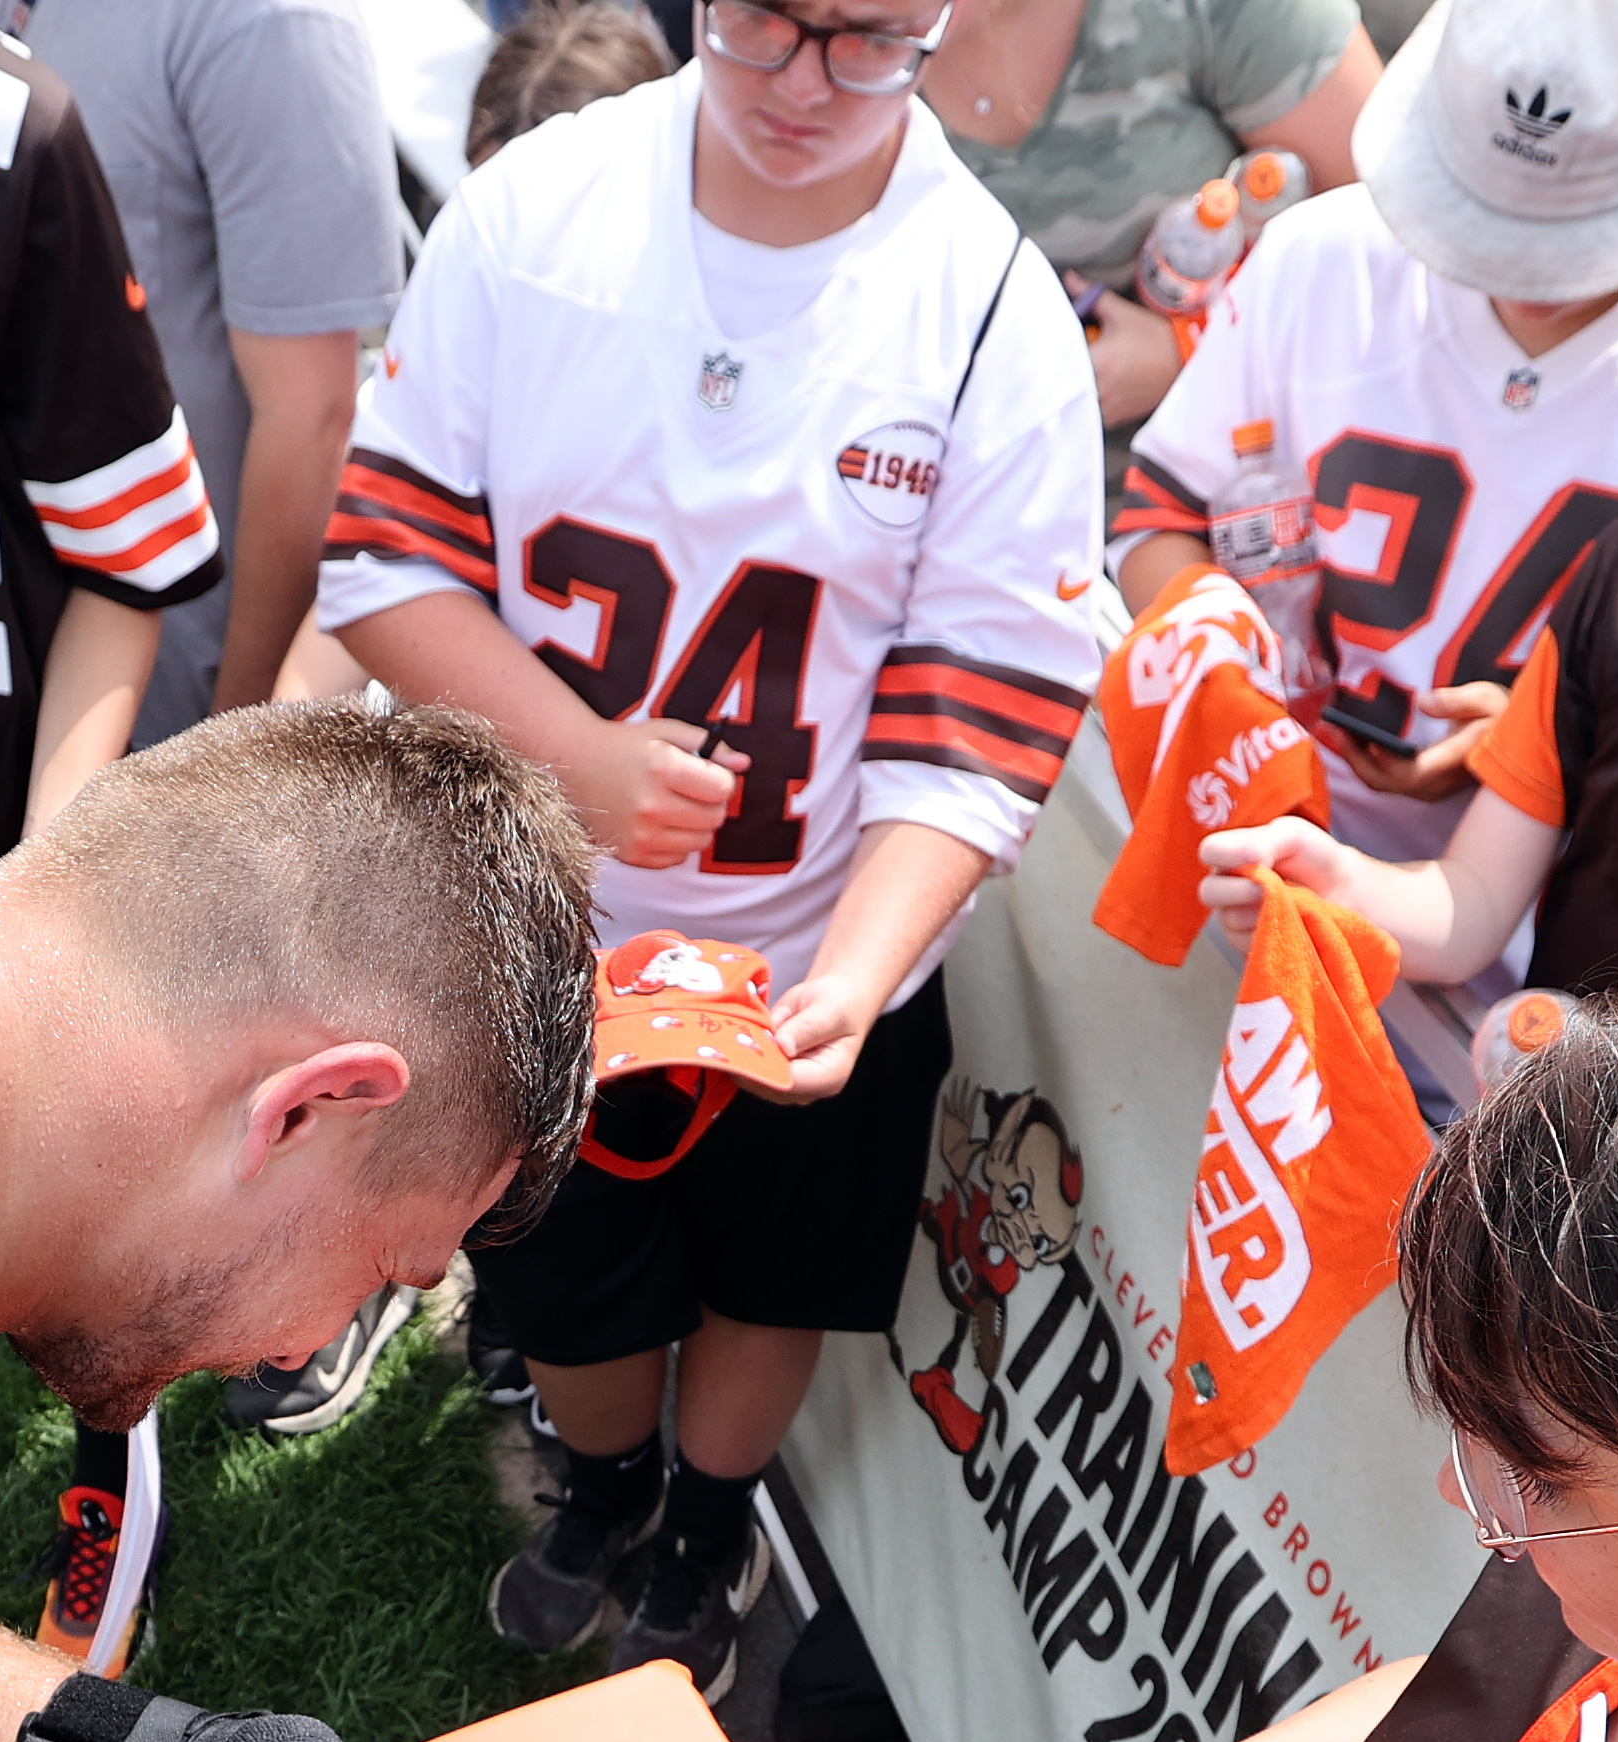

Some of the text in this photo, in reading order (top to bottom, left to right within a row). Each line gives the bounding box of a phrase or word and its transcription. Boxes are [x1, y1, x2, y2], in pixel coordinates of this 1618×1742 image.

[522, 510, 825, 874] 24
[1088, 1225, 1259, 1482] CLEVED
[960, 1382, 1130, 1675] CAMP
